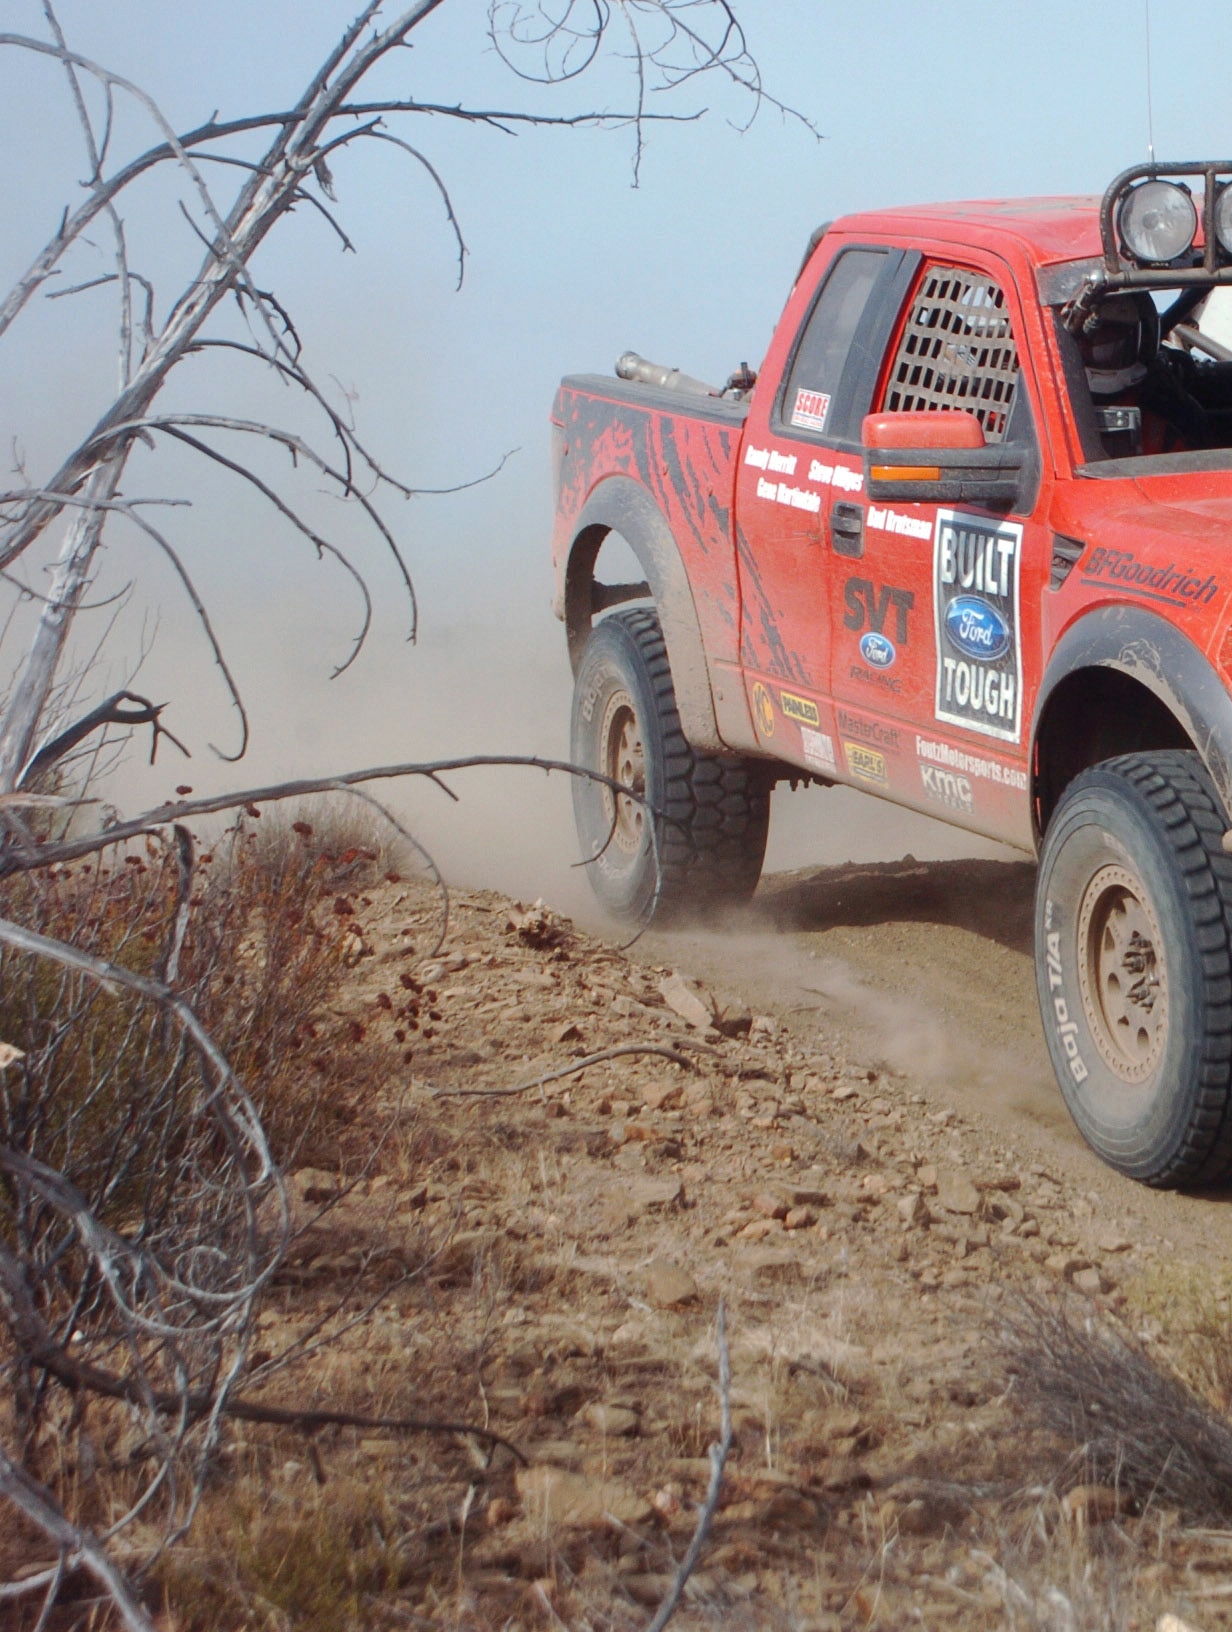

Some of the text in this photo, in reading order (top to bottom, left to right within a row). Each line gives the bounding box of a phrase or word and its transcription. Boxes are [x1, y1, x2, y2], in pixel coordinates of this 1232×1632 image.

[797, 393, 828, 418] SCORE
[941, 528, 1015, 597] BUILT
[1085, 547, 1219, 604] BFGoodrich
[843, 576, 915, 646] SVT
[959, 607, 993, 646] Ford
[865, 637, 890, 663] Ford
[944, 657, 1015, 720] TOUGH
[1046, 931, 1063, 992] T/A
[1054, 997, 1089, 1083] Baja
